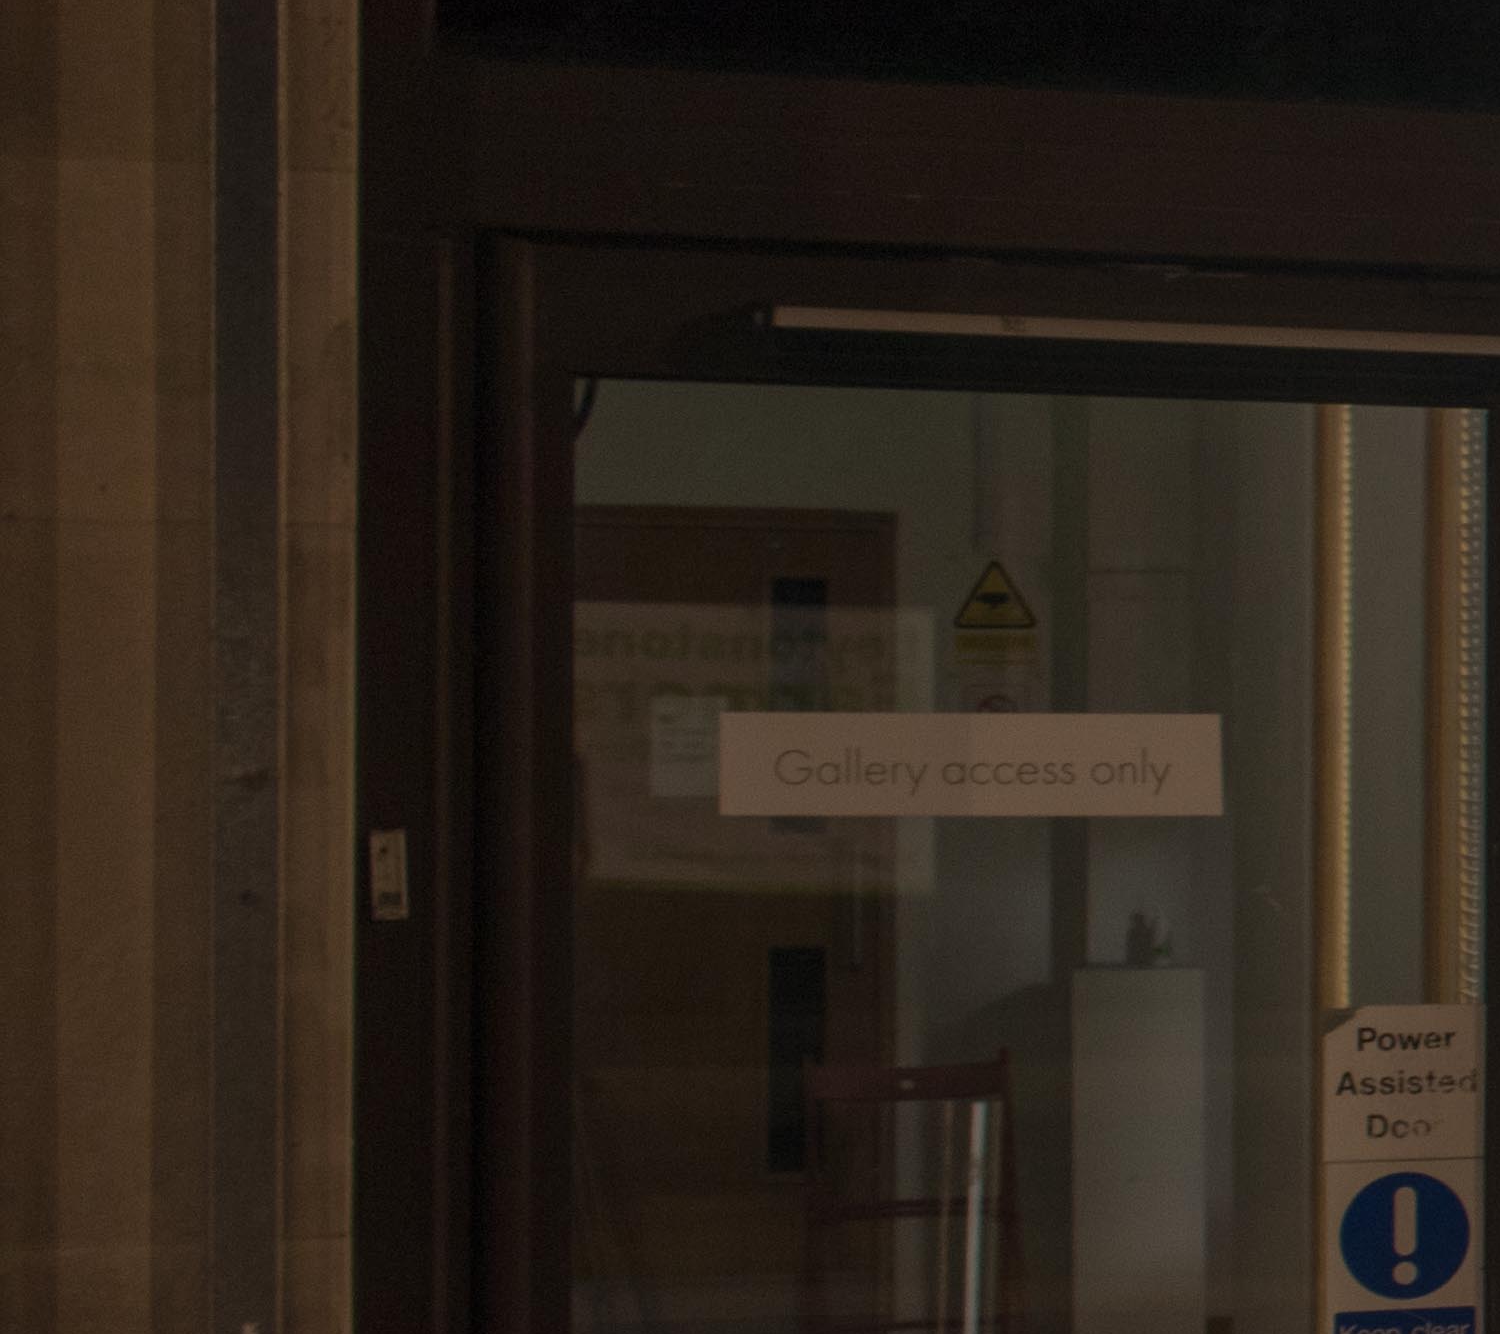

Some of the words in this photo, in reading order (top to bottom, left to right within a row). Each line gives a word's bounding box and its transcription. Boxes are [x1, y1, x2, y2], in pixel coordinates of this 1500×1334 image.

[772, 746, 929, 797] Gallery
[941, 761, 1076, 786] access
[1090, 746, 1172, 796] only
[1357, 1026, 1456, 1052] Power
[1335, 1068, 1479, 1096] Assisted
